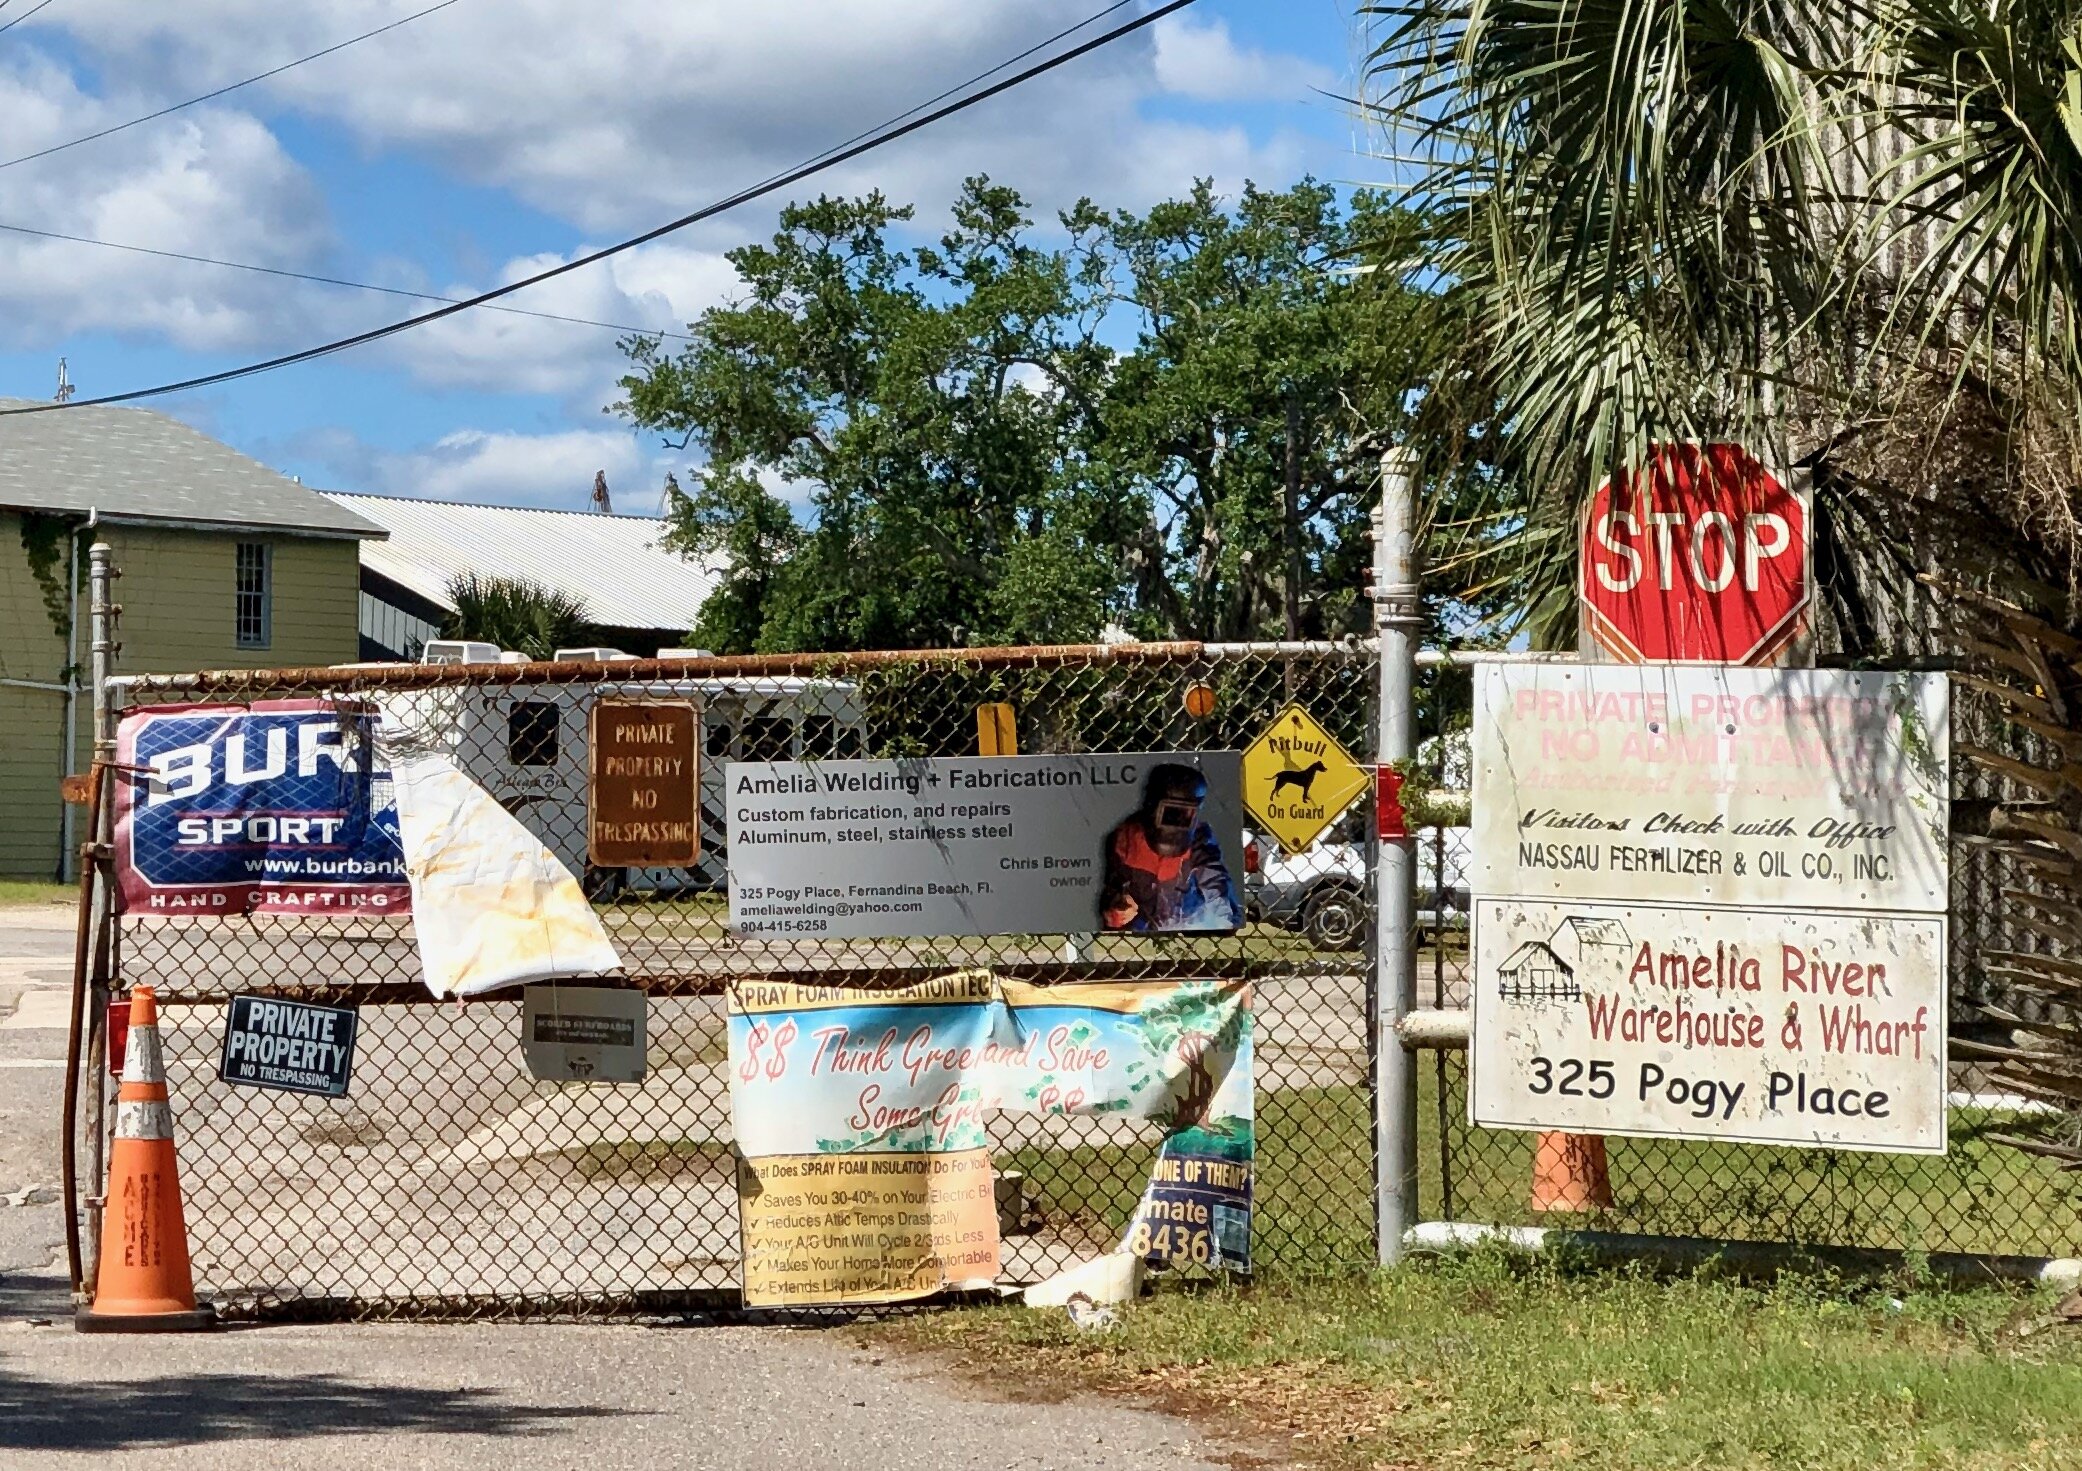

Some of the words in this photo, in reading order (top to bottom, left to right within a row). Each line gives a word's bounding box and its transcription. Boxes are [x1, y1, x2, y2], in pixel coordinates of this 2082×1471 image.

[1595, 511, 1790, 593] STOP
[1515, 689, 1668, 724] PRIVATE
[615, 723, 675, 745] PRIVATE
[1541, 728, 1600, 762] NO
[1269, 735, 1328, 757] Pitbull
[605, 756, 683, 777] PROPERTY
[737, 774, 817, 795] Amelia
[823, 771, 920, 796] Welding
[949, 766, 1083, 790] Fabrication
[1090, 764, 1138, 786] LLC
[631, 788, 658, 810] NO
[737, 807, 804, 823] Custom
[810, 804, 908, 821] fabrication,
[913, 803, 945, 818] and
[951, 802, 1011, 820] repairs
[1268, 803, 1284, 819] On
[1290, 803, 1324, 820] Guard
[177, 817, 345, 845] SPORT
[596, 820, 694, 843] TRESPASSING
[738, 828, 832, 845] Aluminum,
[837, 826, 883, 844] steel,
[888, 825, 966, 841] stainless
[971, 823, 1013, 838] steel
[1518, 808, 1631, 832] Visitors
[1643, 811, 1724, 835] Check
[1731, 816, 1798, 838] with
[1807, 816, 1897, 849] Office
[1000, 856, 1039, 870] Chris
[1043, 855, 1091, 869] Brown
[1518, 841, 1600, 872] NASSAU
[1733, 851, 1747, 877] &
[1758, 850, 1792, 878] OIL
[1801, 852, 1843, 885] CO.,
[1853, 853, 1894, 881] INC.
[739, 888, 762, 899] 325
[767, 887, 800, 901] Pogy
[849, 884, 924, 897] Fernandina
[1050, 875, 1092, 888] owner
[150, 893, 228, 909] HAND
[247, 890, 390, 907] CRAFTING
[740, 901, 923, 917] ameliawelding@yahoo.com
[741, 919, 827, 933] 904-415-6258
[1629, 941, 1761, 992] Amelia
[1781, 945, 1886, 997] River
[734, 986, 788, 1008] SPRAY
[796, 985, 845, 1004] FOAM
[957, 974, 999, 998] TEC
[247, 1001, 338, 1043] PRIVATE
[1586, 993, 1765, 1049] Warehouse
[1781, 1001, 1803, 1052] &
[1819, 1003, 1928, 1060] Wharf
[229, 1030, 347, 1075] PROPERTY
[811, 1026, 895, 1076] Think
[984, 1031, 1039, 1068] and
[1039, 1026, 1110, 1071] Save
[240, 1062, 256, 1078] NO
[260, 1065, 331, 1088] TRESPASSING
[1529, 1056, 1616, 1100] 325
[1639, 1063, 1746, 1121] Pogy
[1768, 1071, 1891, 1119] Place
[851, 1083, 923, 1131] Some
[772, 1163, 798, 1178] Does
[801, 1161, 836, 1177] SPRAY
[838, 1160, 868, 1175] FOAM
[871, 1160, 931, 1175] INSULATION
[934, 1160, 949, 1173] Do
[952, 1159, 967, 1173] For
[1154, 1159, 1181, 1182] ONE
[1184, 1160, 1203, 1183] OF
[763, 1194, 802, 1208] Saves
[804, 1191, 828, 1206] You
[831, 1189, 880, 1205] 30-40%
[883, 1192, 898, 1204] on
[900, 1190, 928, 1204] Your
[931, 1187, 976, 1204] Electric
[853, 1211, 895, 1229] Temps
[1146, 1198, 1208, 1224] mate
[765, 1237, 793, 1251] Your
[823, 1233, 849, 1249] Unit
[851, 1233, 874, 1248] Will
[877, 1232, 912, 1251] Cycle
[955, 1230, 984, 1244] Less
[1131, 1222, 1208, 1265] 8436
[767, 1258, 809, 1273] Makes
[811, 1256, 839, 1272] Your
[768, 1280, 820, 1296] Extends
